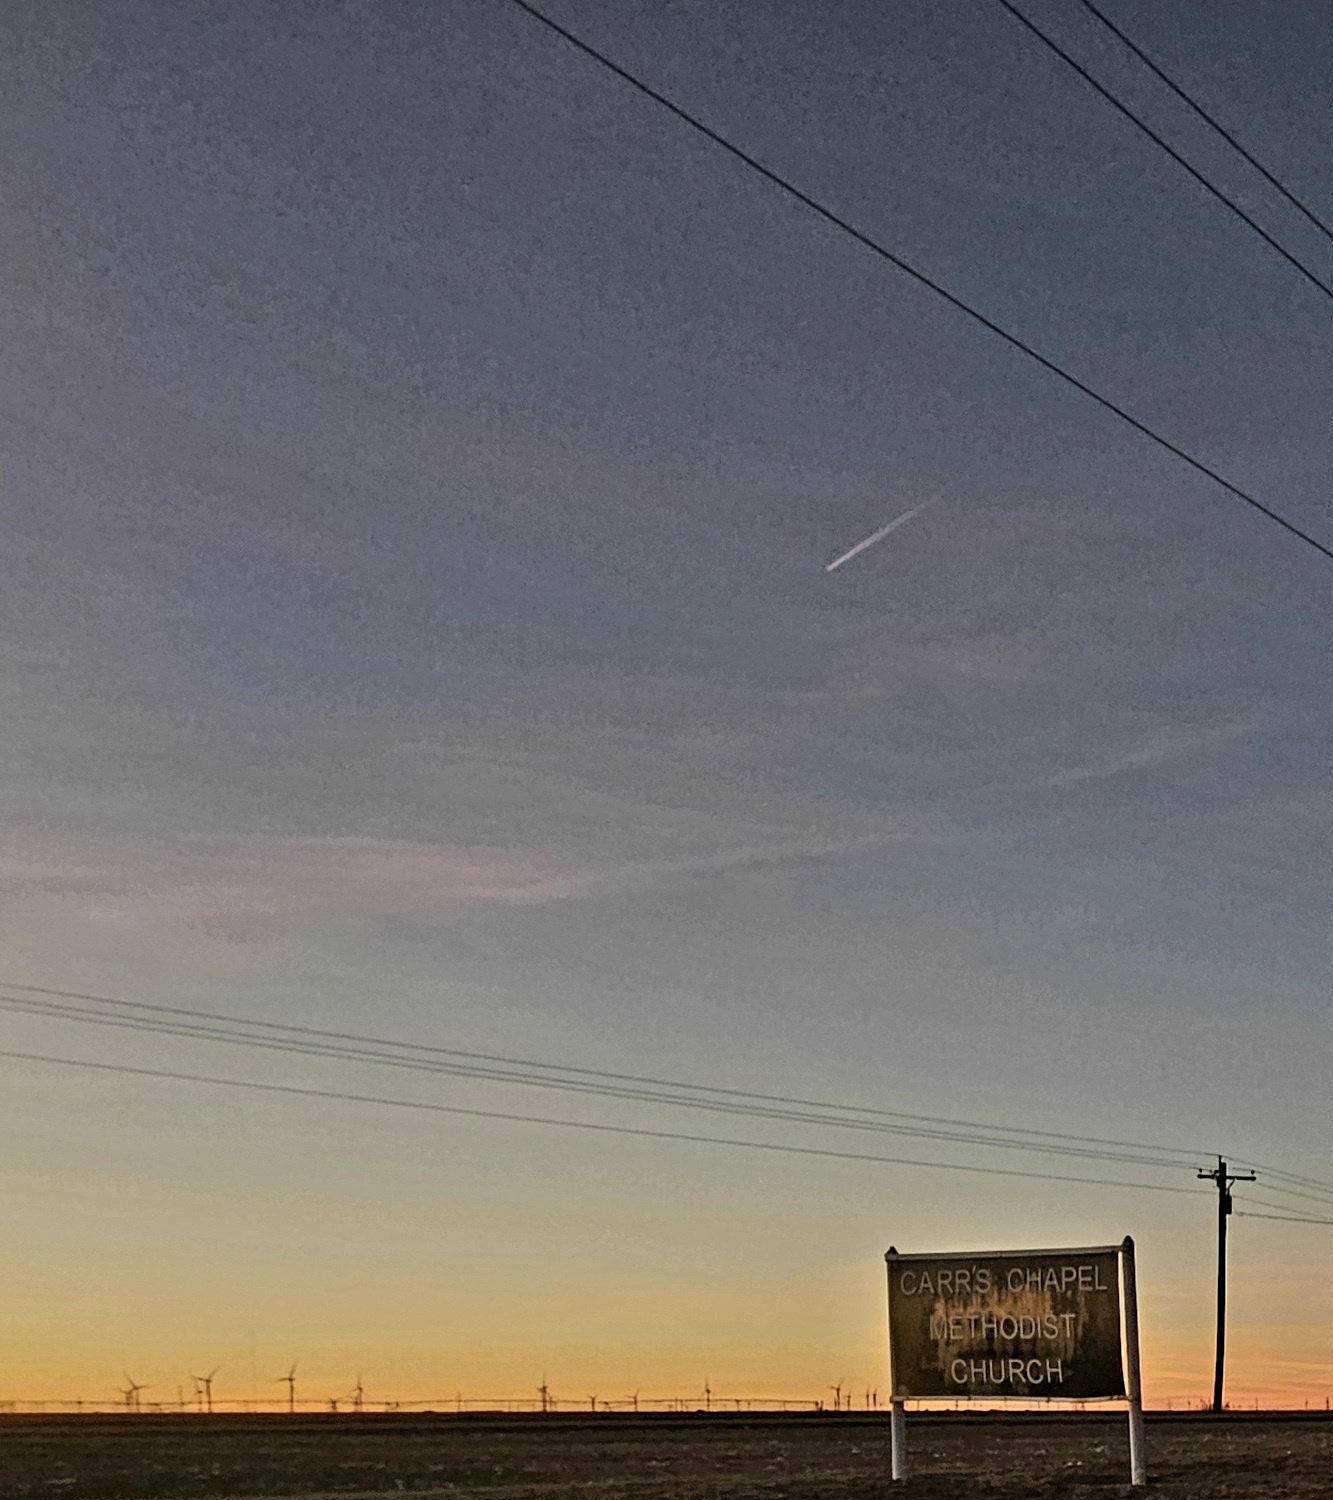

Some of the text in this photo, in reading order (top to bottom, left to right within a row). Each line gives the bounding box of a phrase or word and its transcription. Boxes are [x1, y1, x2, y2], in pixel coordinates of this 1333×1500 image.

[900, 1265, 1109, 1296] CARR'S CHAPEL
[929, 1313, 1076, 1341] METHODIST
[950, 1358, 1064, 1385] CHURCH
